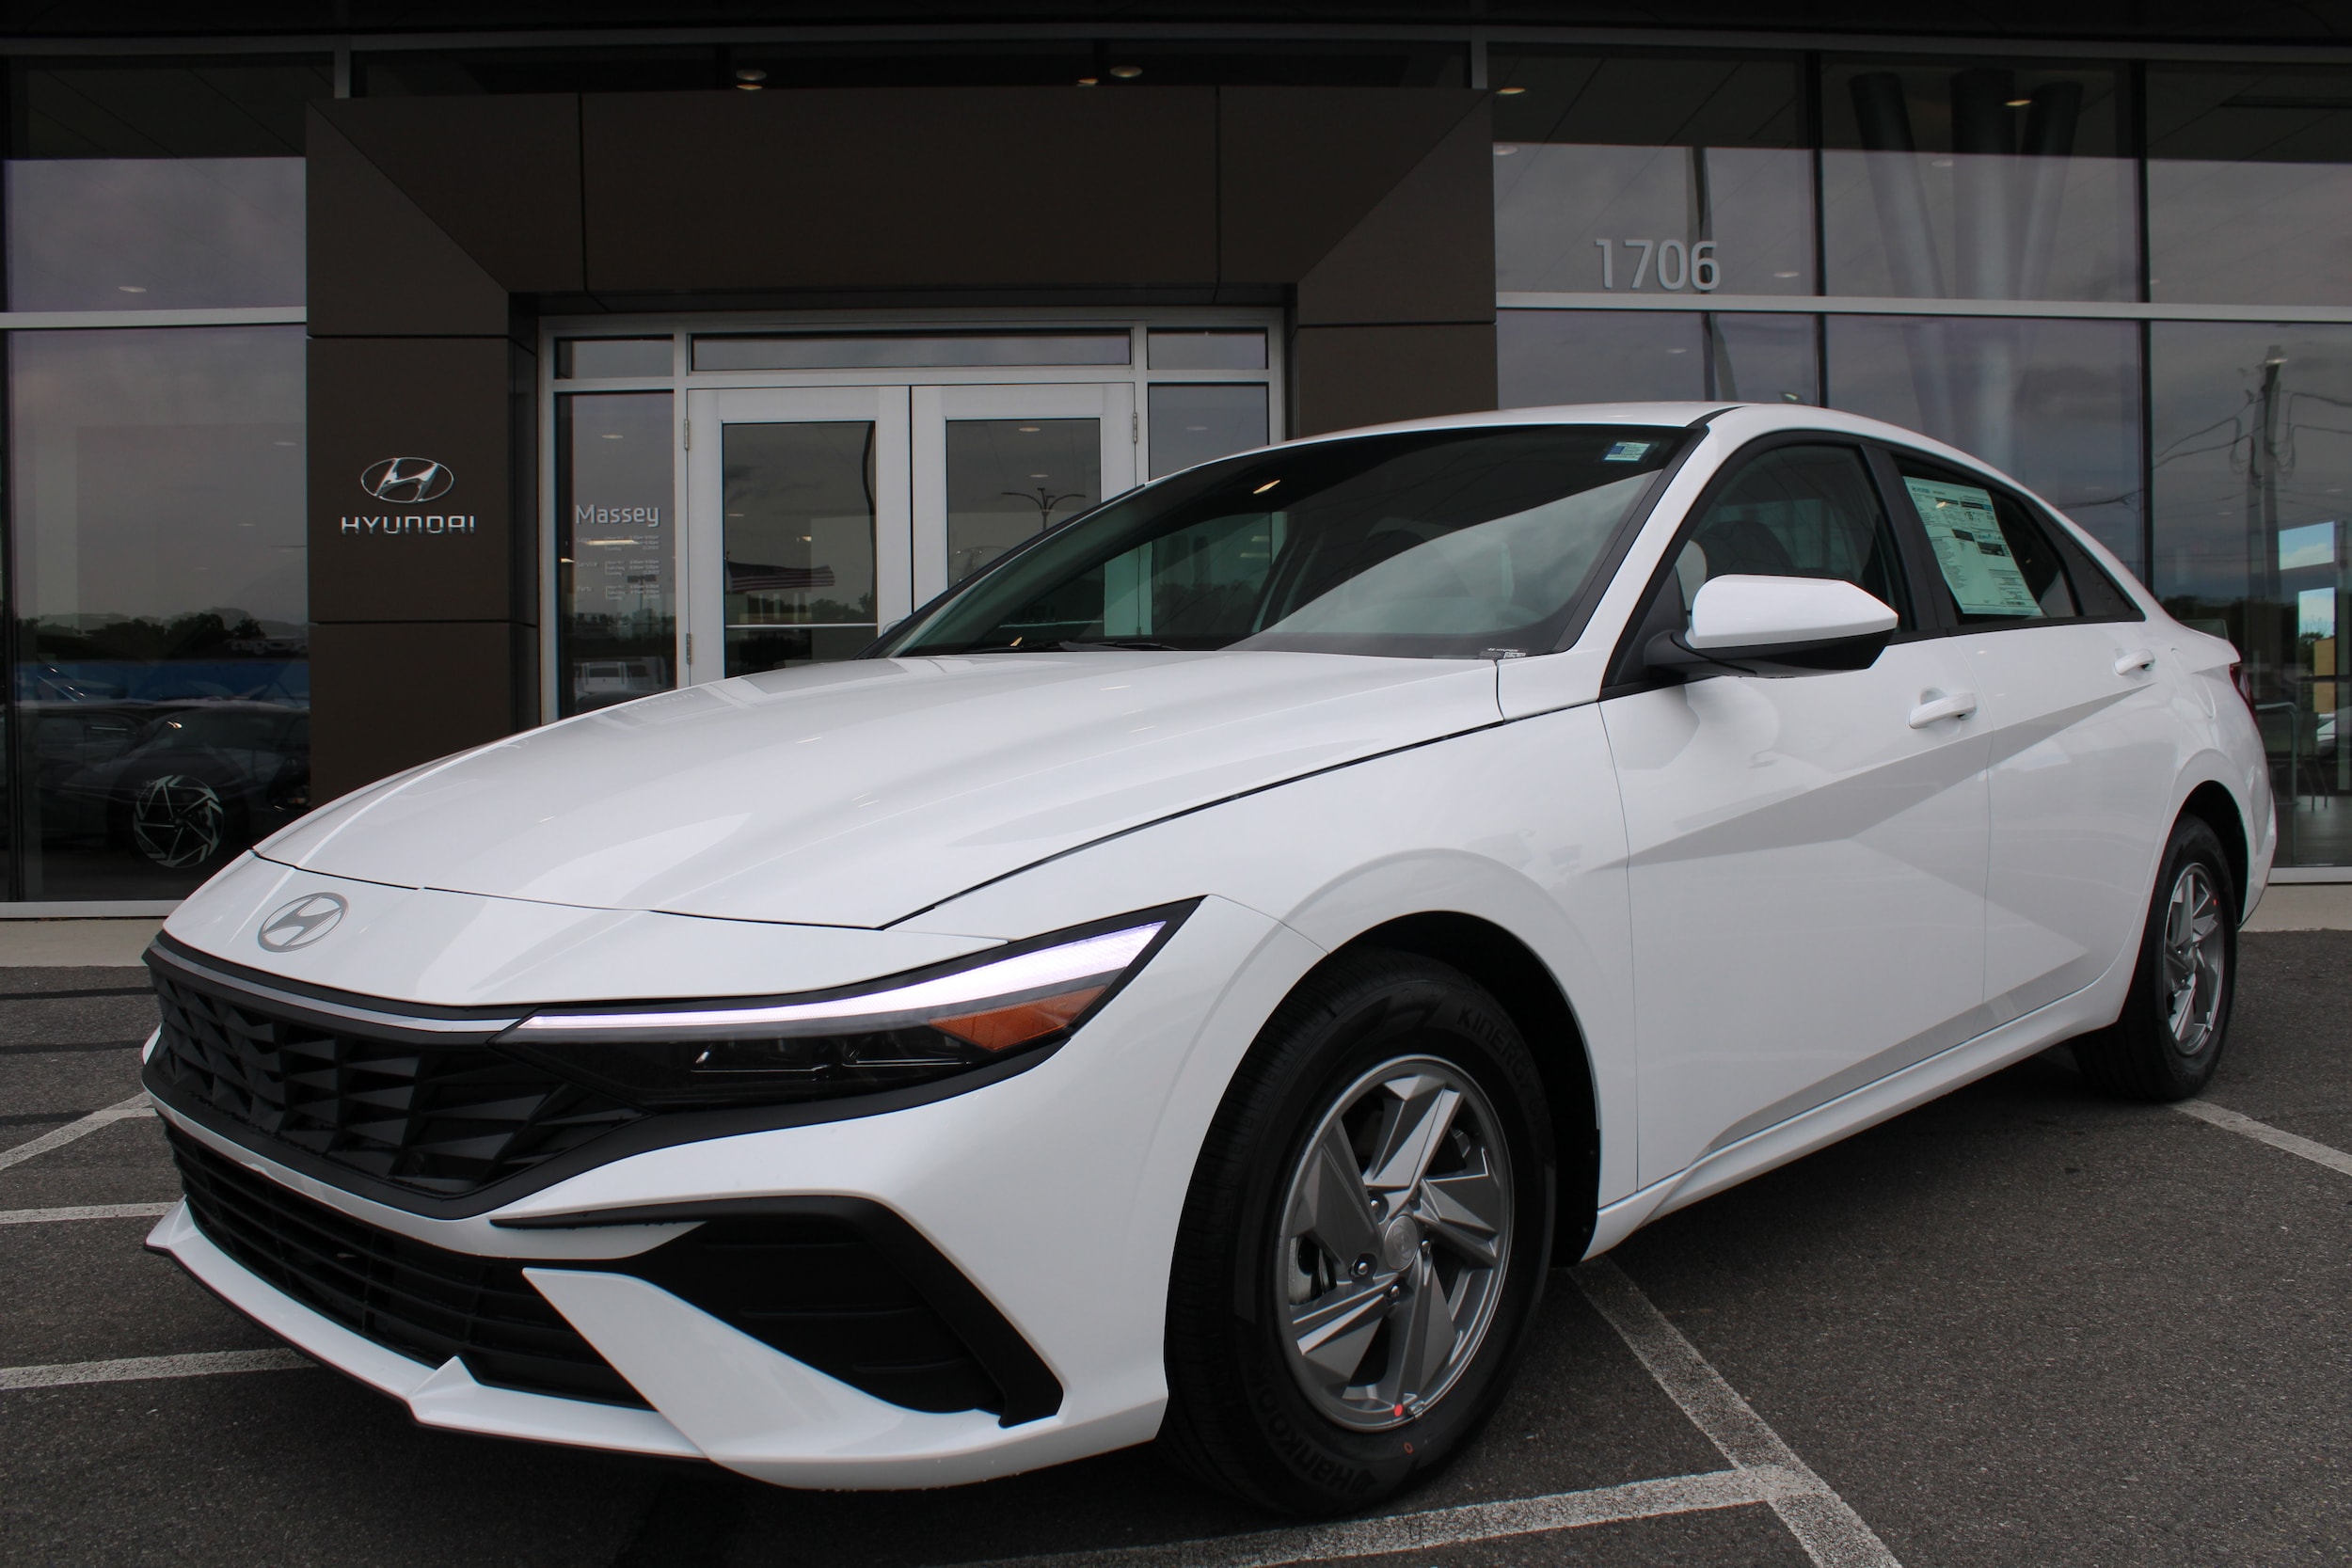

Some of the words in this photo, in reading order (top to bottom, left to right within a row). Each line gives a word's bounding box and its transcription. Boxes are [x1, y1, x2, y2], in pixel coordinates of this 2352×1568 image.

[1596, 239, 1721, 291] 1706
[341, 515, 476, 535] HYUNDAI
[575, 504, 660, 528] Massey
